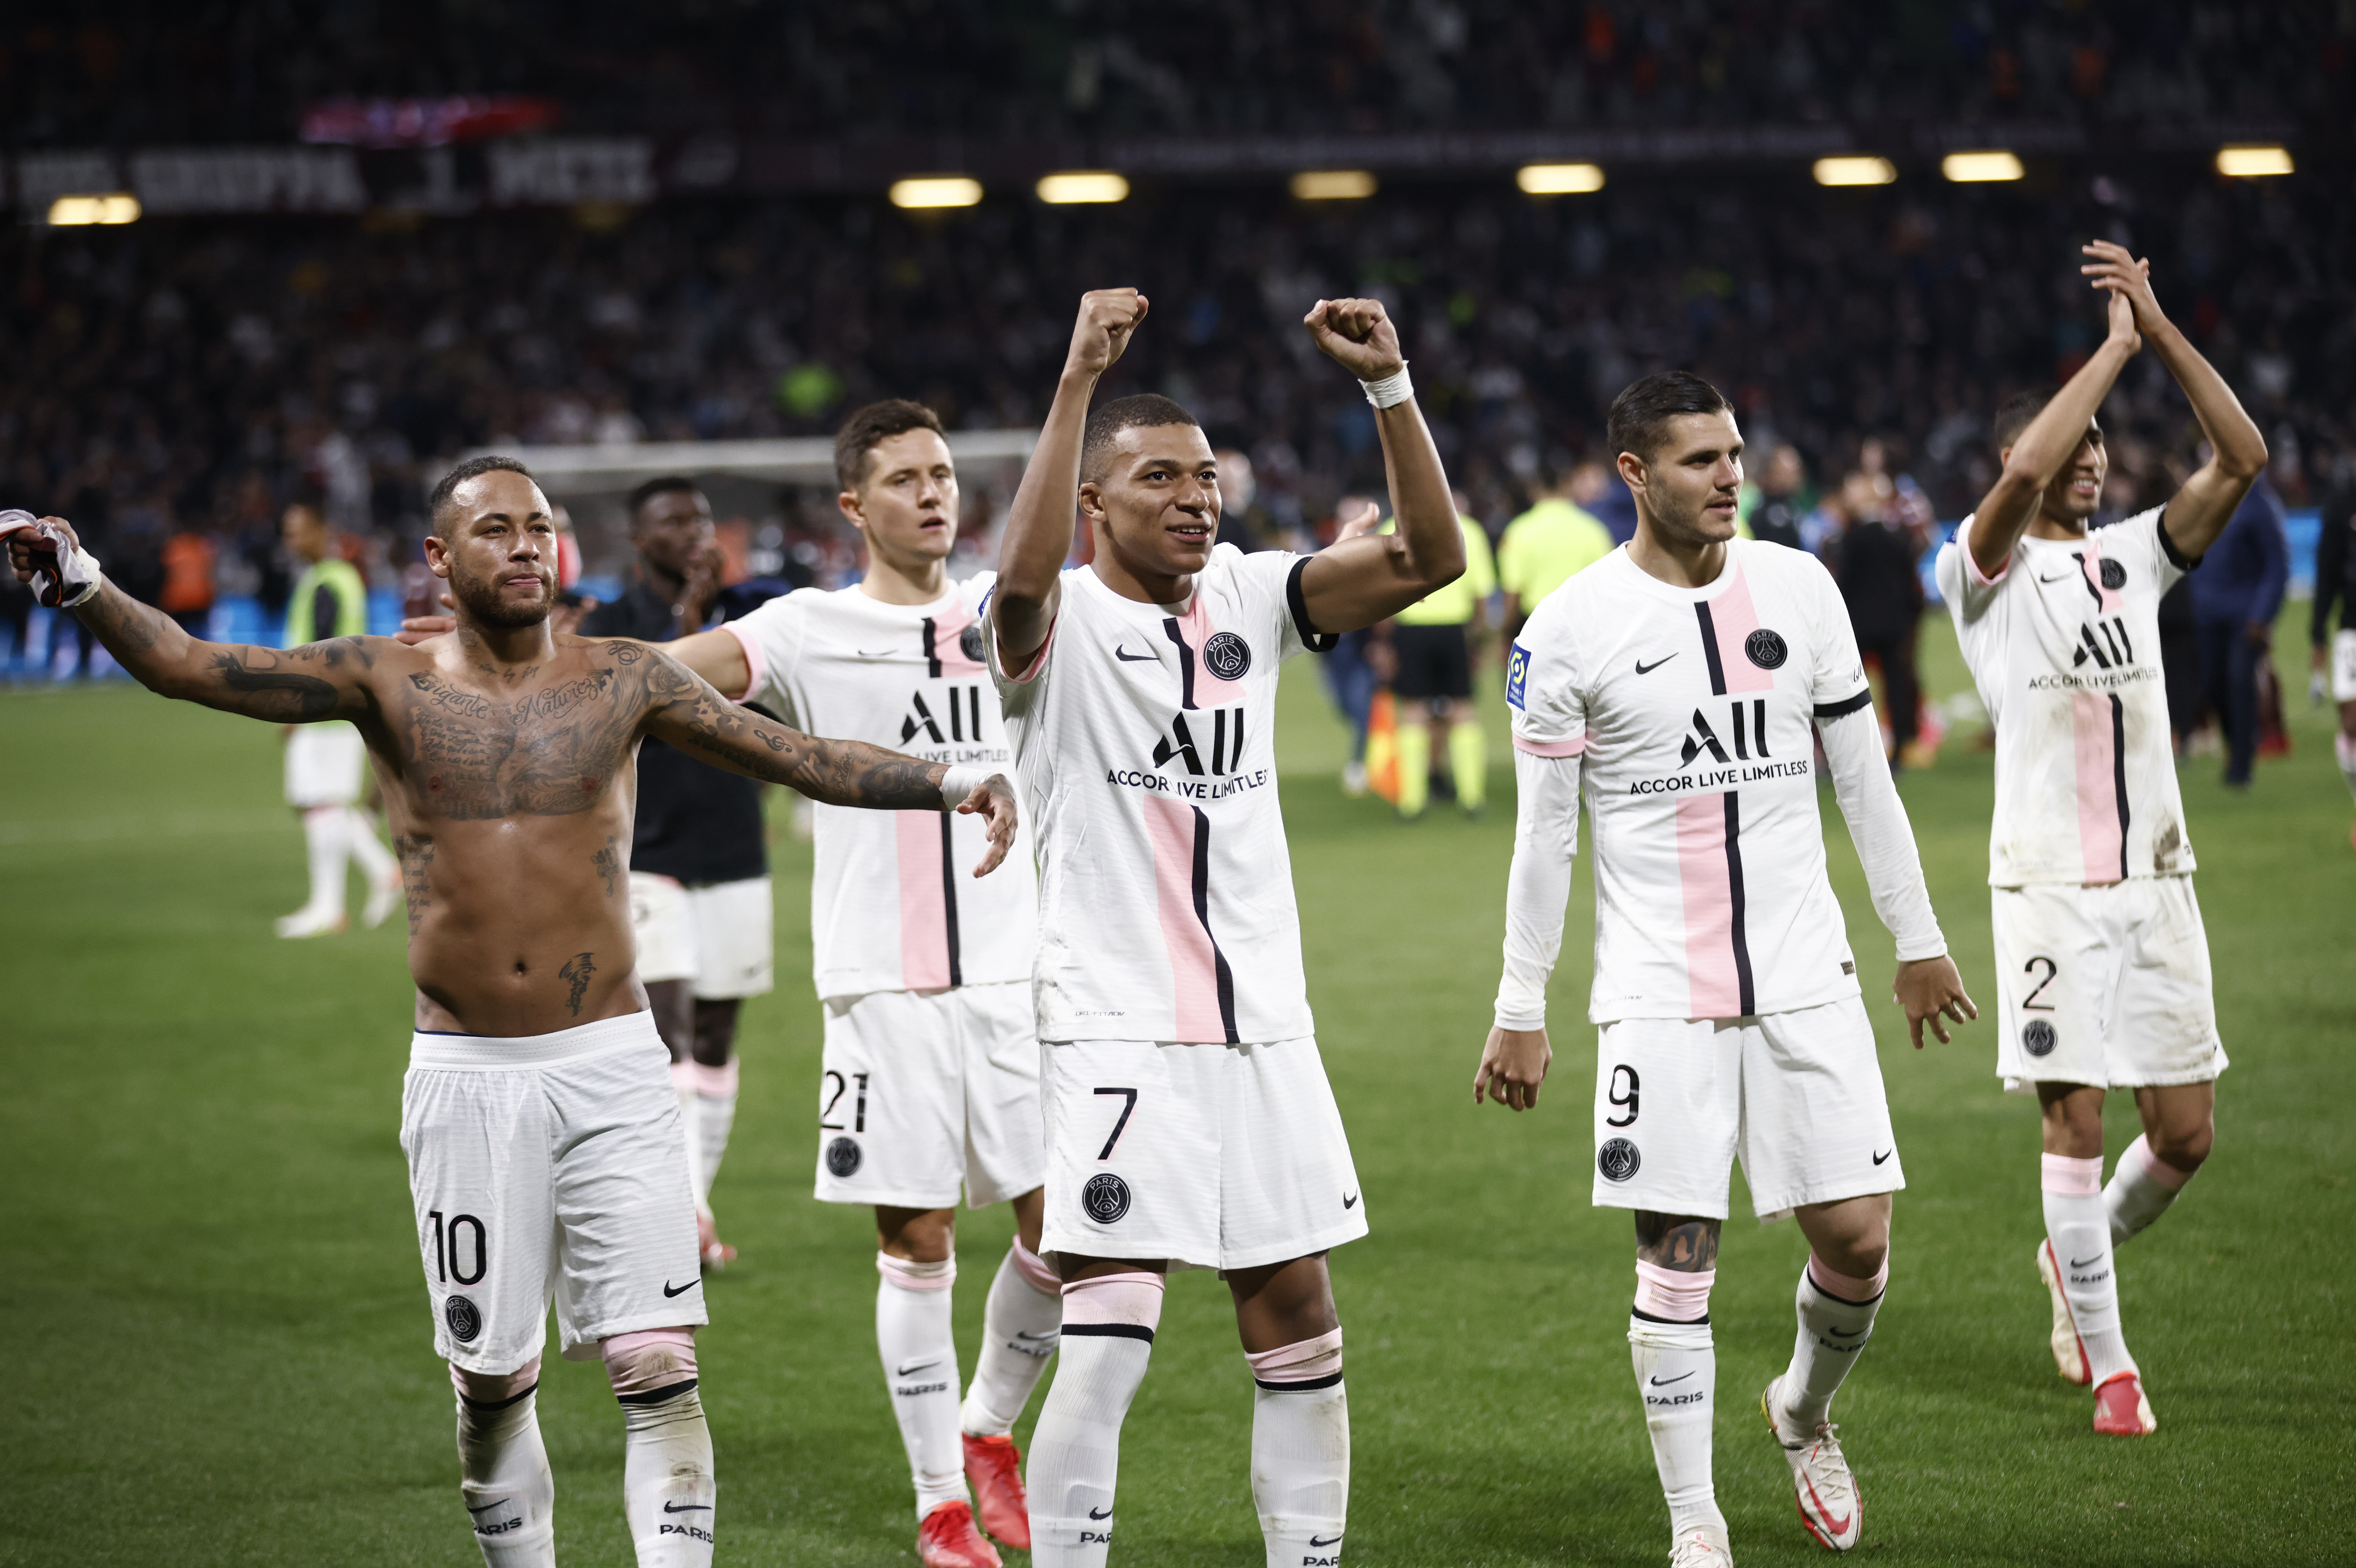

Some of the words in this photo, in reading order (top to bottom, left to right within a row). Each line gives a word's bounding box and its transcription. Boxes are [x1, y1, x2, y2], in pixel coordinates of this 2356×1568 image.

[1208, 636, 1235, 652] PARIS
[1751, 632, 1776, 643] PARIS
[1233, 661, 1245, 674] GERMAIN
[2029, 674, 2084, 691] ACCOR
[2086, 673, 2117, 689] LIVE
[957, 749, 1009, 762] LIMITLES
[1107, 769, 1170, 791] ACCOR
[1630, 776, 1693, 794] ACCOR
[1699, 769, 1738, 787] LIVE
[1742, 760, 1808, 781] LIMITLESS
[2023, 956, 2056, 1011] 2
[820, 1070, 868, 1132] 21
[1606, 1064, 1639, 1127] 9
[1094, 1087, 1137, 1160] 7
[1605, 1140, 1632, 1152] PARIS
[1089, 1178, 1119, 1190] PARIS
[1106, 1208, 1121, 1218] GERMAIN
[430, 1211, 487, 1286] 10
[2070, 1267, 2109, 1283] PARIS
[448, 1299, 469, 1310] PARIS
[897, 1382, 948, 1396] PARIS
[1647, 1391, 1703, 1405] PARIS
[660, 1525, 713, 1544] PARIS
